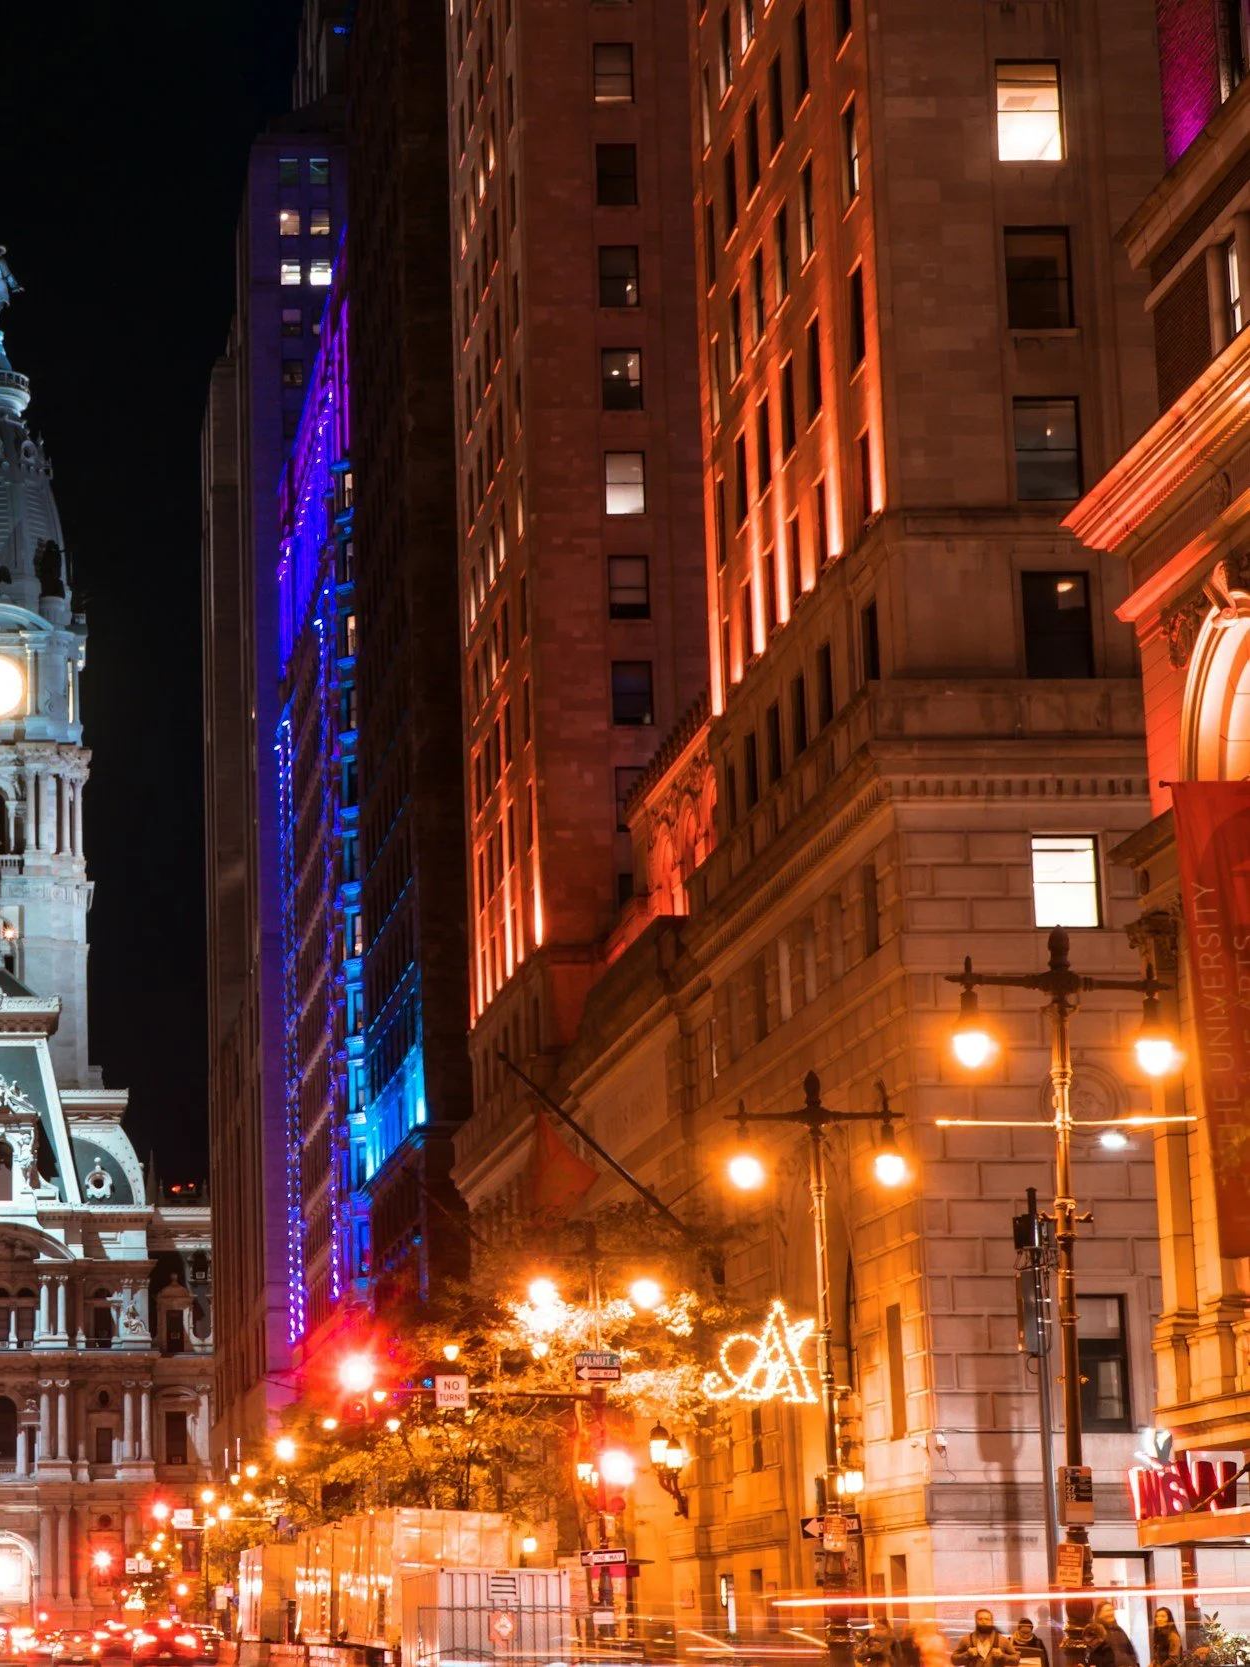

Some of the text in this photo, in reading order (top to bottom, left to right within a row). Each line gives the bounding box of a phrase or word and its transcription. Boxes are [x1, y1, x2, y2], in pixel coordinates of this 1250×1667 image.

[1191, 882, 1235, 1073] UNIVERSITY
[575, 1355, 610, 1367] WALNUT
[444, 1381, 460, 1391] NO
[439, 1393, 466, 1402] TURNS
[1066, 1484, 1076, 1493] 27
[1067, 1493, 1077, 1502] 32
